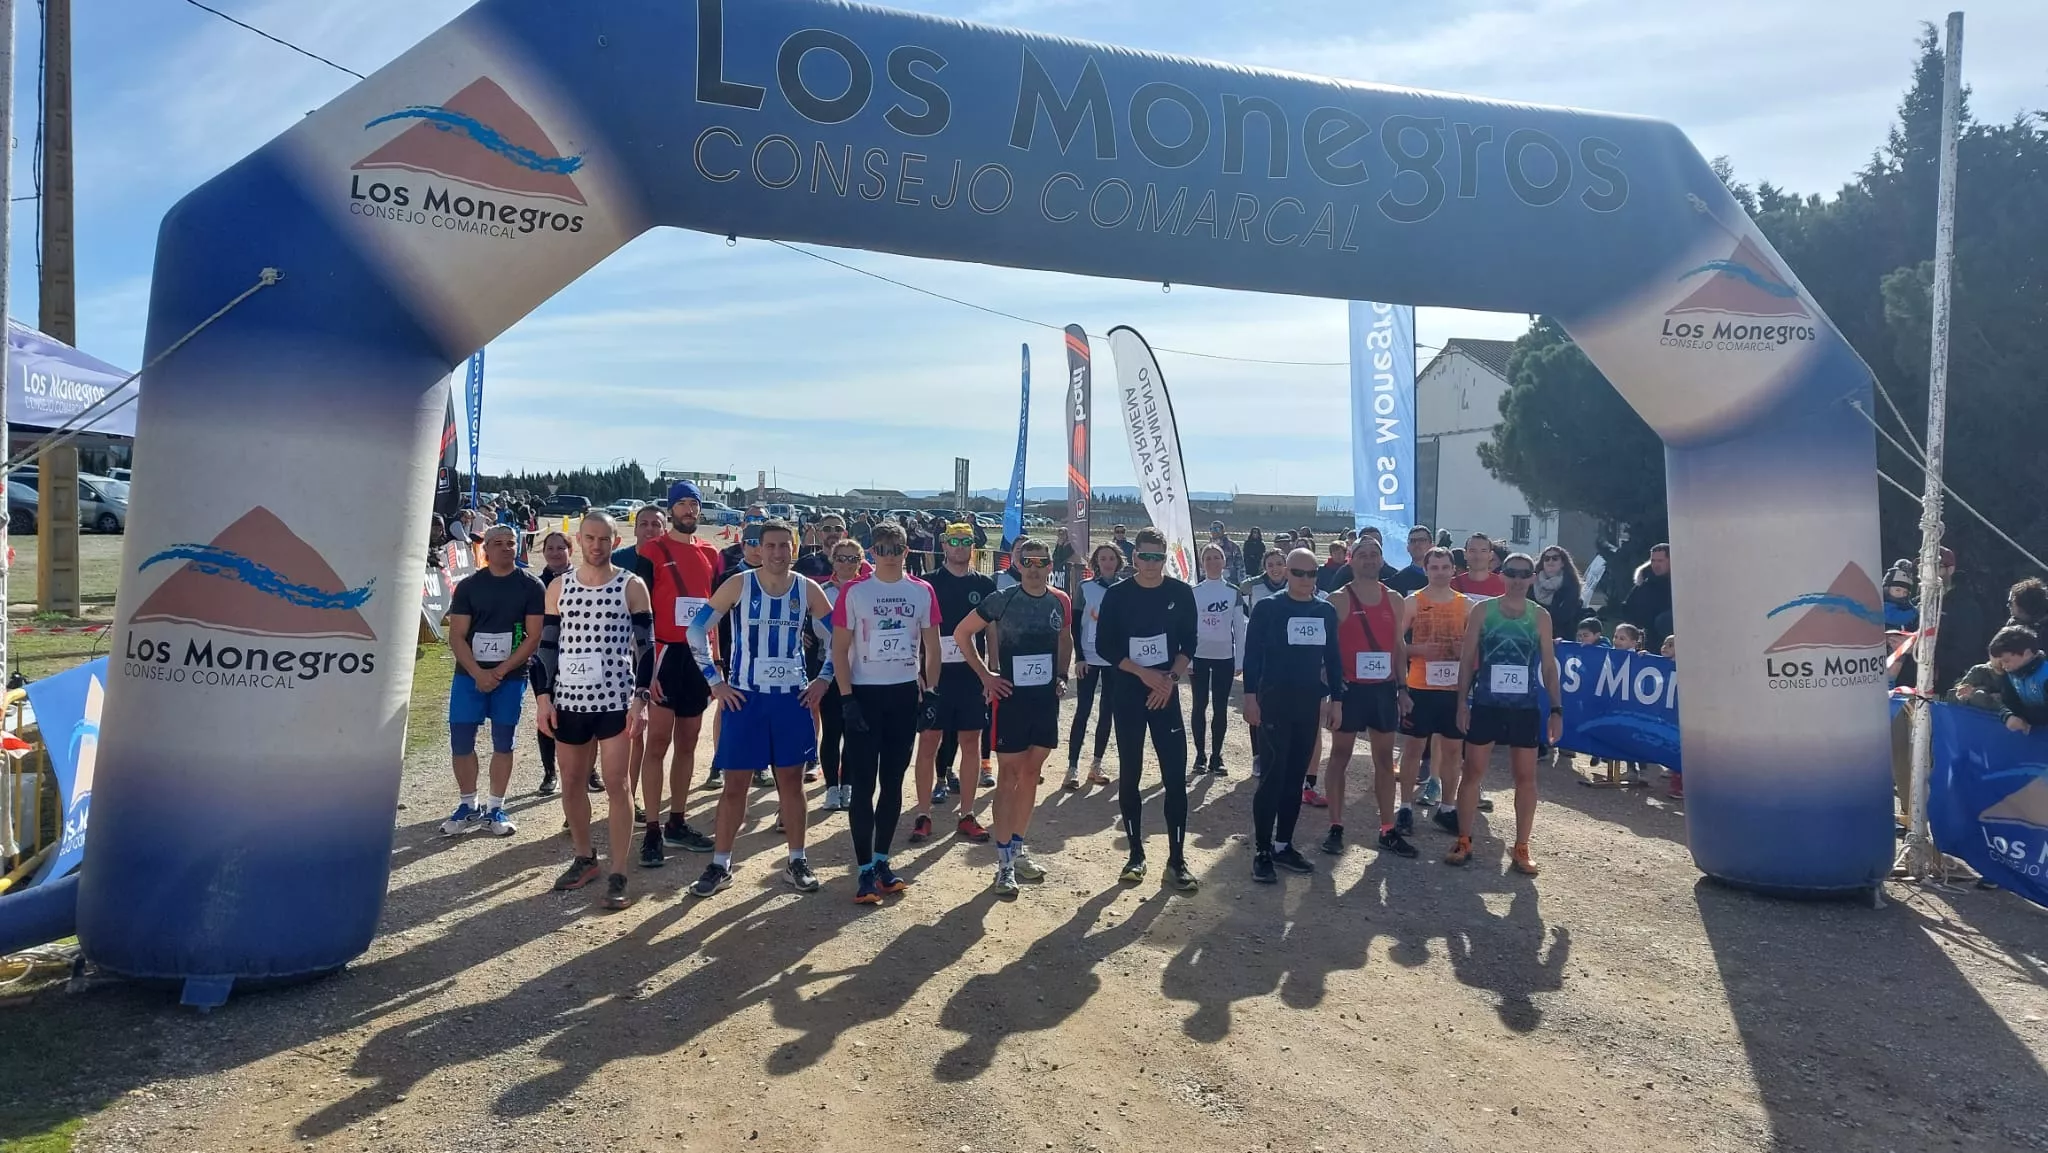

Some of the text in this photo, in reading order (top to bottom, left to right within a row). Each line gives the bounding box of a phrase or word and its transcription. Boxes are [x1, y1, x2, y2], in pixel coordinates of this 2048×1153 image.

[695, 0, 1631, 223] Los Monegros
[693, 125, 1361, 252] CONSEJO COMARCAL
[350, 174, 585, 234] Los Monegros
[350, 202, 516, 240] CONSEJO COMARCAL
[1662, 318, 1816, 345] Los Monegros
[1659, 336, 1776, 352] CONSEJO COMARCAL
[23, 364, 46, 396] Los
[1299, 625, 1315, 637] 48
[483, 641, 499, 653] 74
[883, 638, 900, 651] 97
[1142, 643, 1157, 656] 98
[125, 630, 376, 681] Los Monegros
[569, 662, 586, 675] 24
[768, 666, 786, 679] 29
[1026, 663, 1042, 676] 75
[1367, 660, 1382, 672] 54
[1438, 667, 1451, 679] 19
[1766, 657, 1814, 678] Los
[123, 661, 295, 690] CONSEJO COMARCAL
[1503, 672, 1519, 684] 78
[1768, 678, 1828, 690] CONSEJO
[1982, 826, 2026, 860] Los
